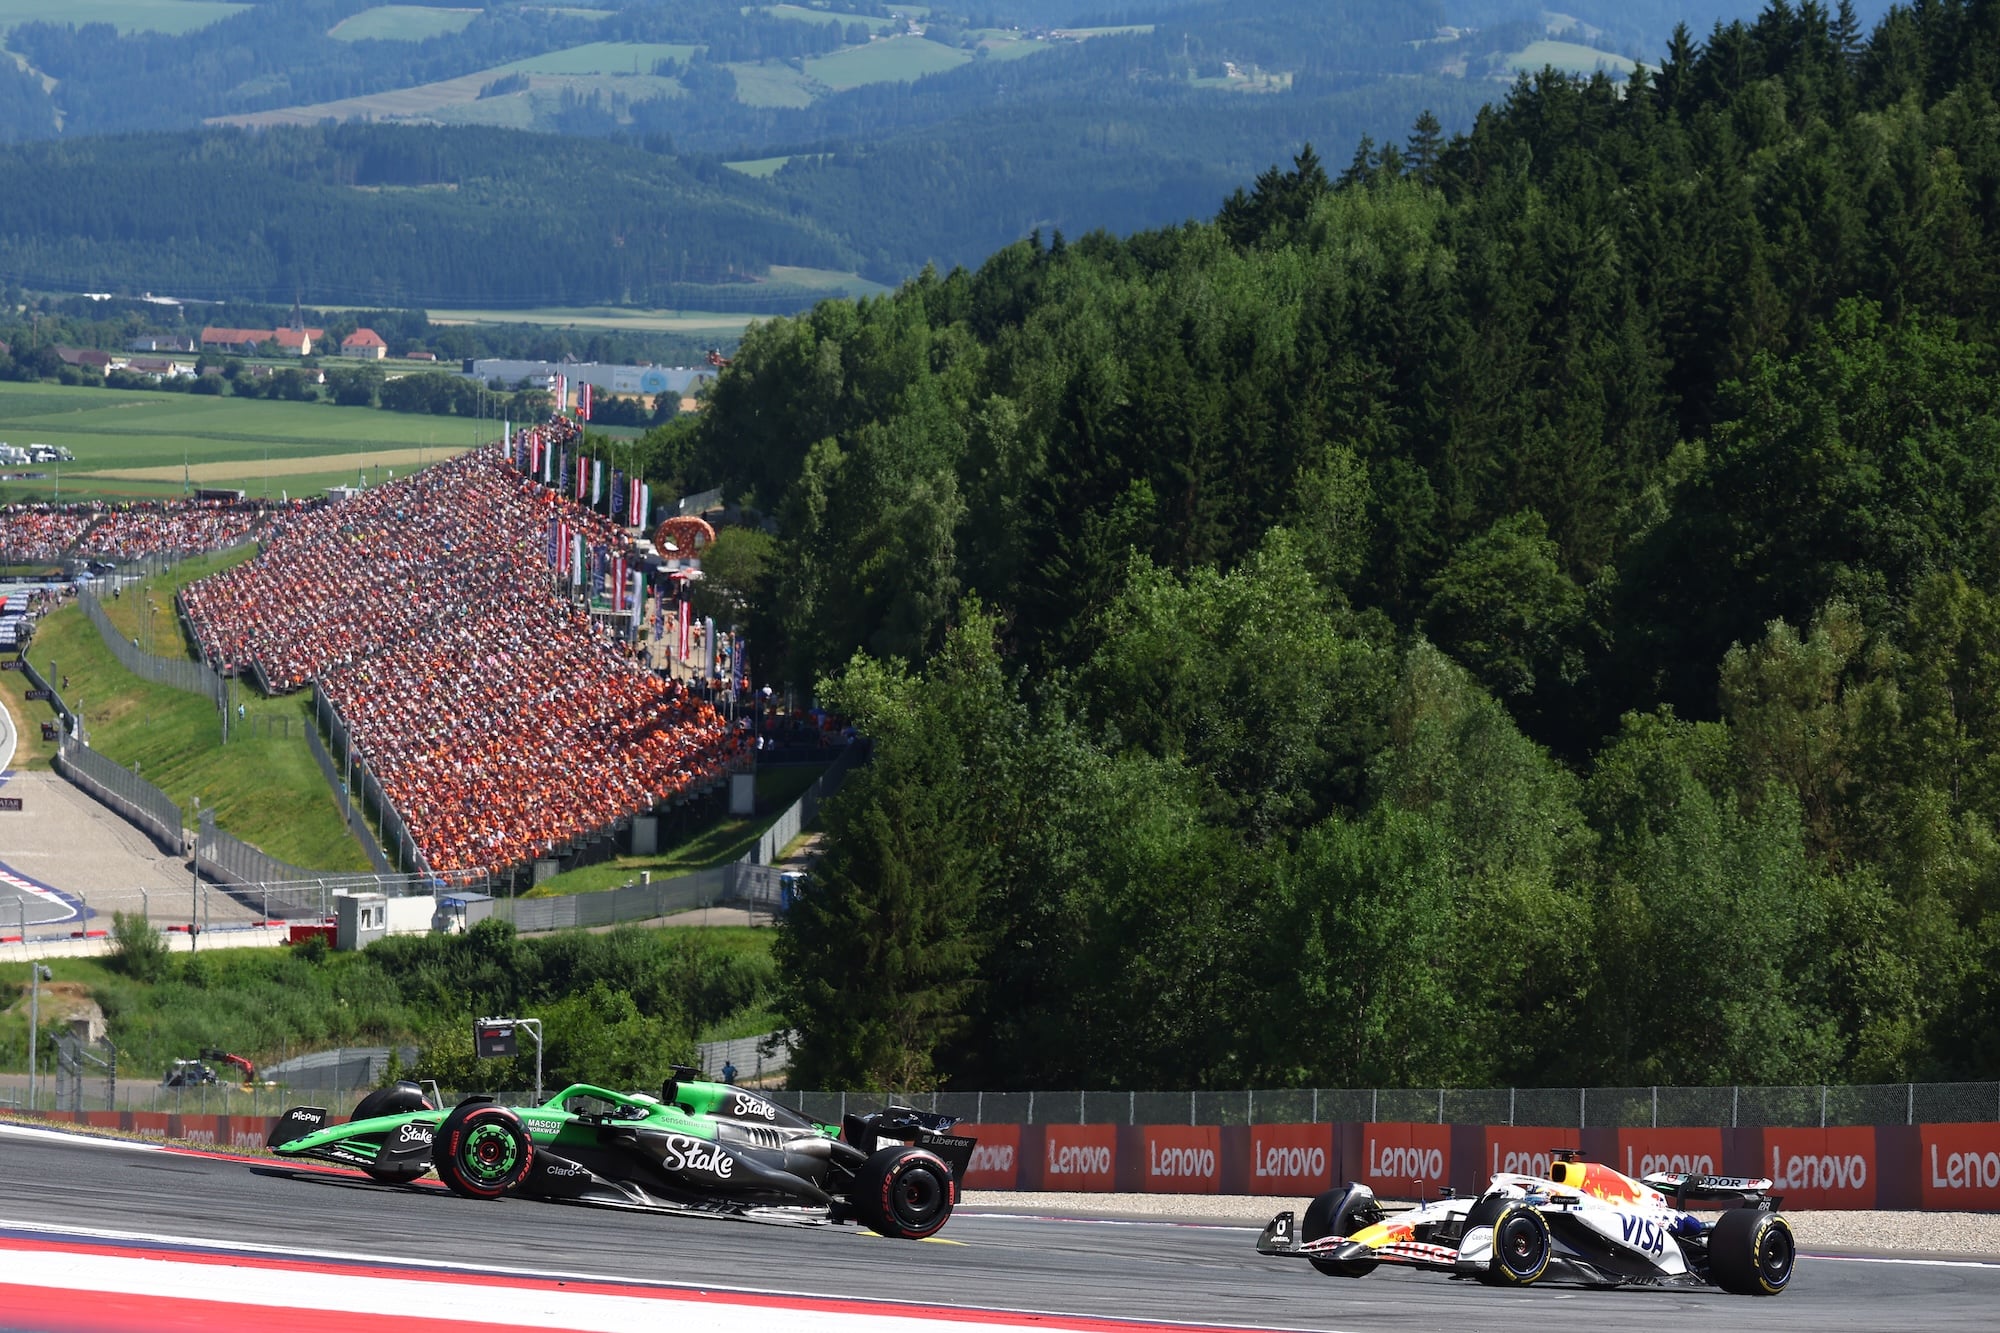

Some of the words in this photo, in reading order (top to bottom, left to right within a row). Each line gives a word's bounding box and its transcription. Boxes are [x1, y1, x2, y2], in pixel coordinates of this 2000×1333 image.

[291, 1111, 321, 1124] PicPay
[527, 1119, 561, 1129] MASCOT
[734, 1093, 775, 1120] Stake
[400, 1124, 433, 1143] Stake
[931, 1137, 969, 1147] Libertex
[547, 1165, 574, 1177] Claro
[662, 1134, 734, 1179] Stake
[966, 1145, 1014, 1172] novo
[1049, 1139, 1110, 1174] Lenovo
[1150, 1140, 1215, 1177] Lenovo
[1255, 1139, 1326, 1178] Lenovo
[1369, 1139, 1443, 1180] Lenovo
[1773, 1145, 1867, 1190] Lenovo
[1931, 1143, 2000, 1188] Leno
[1613, 1212, 1665, 1258] VISA
